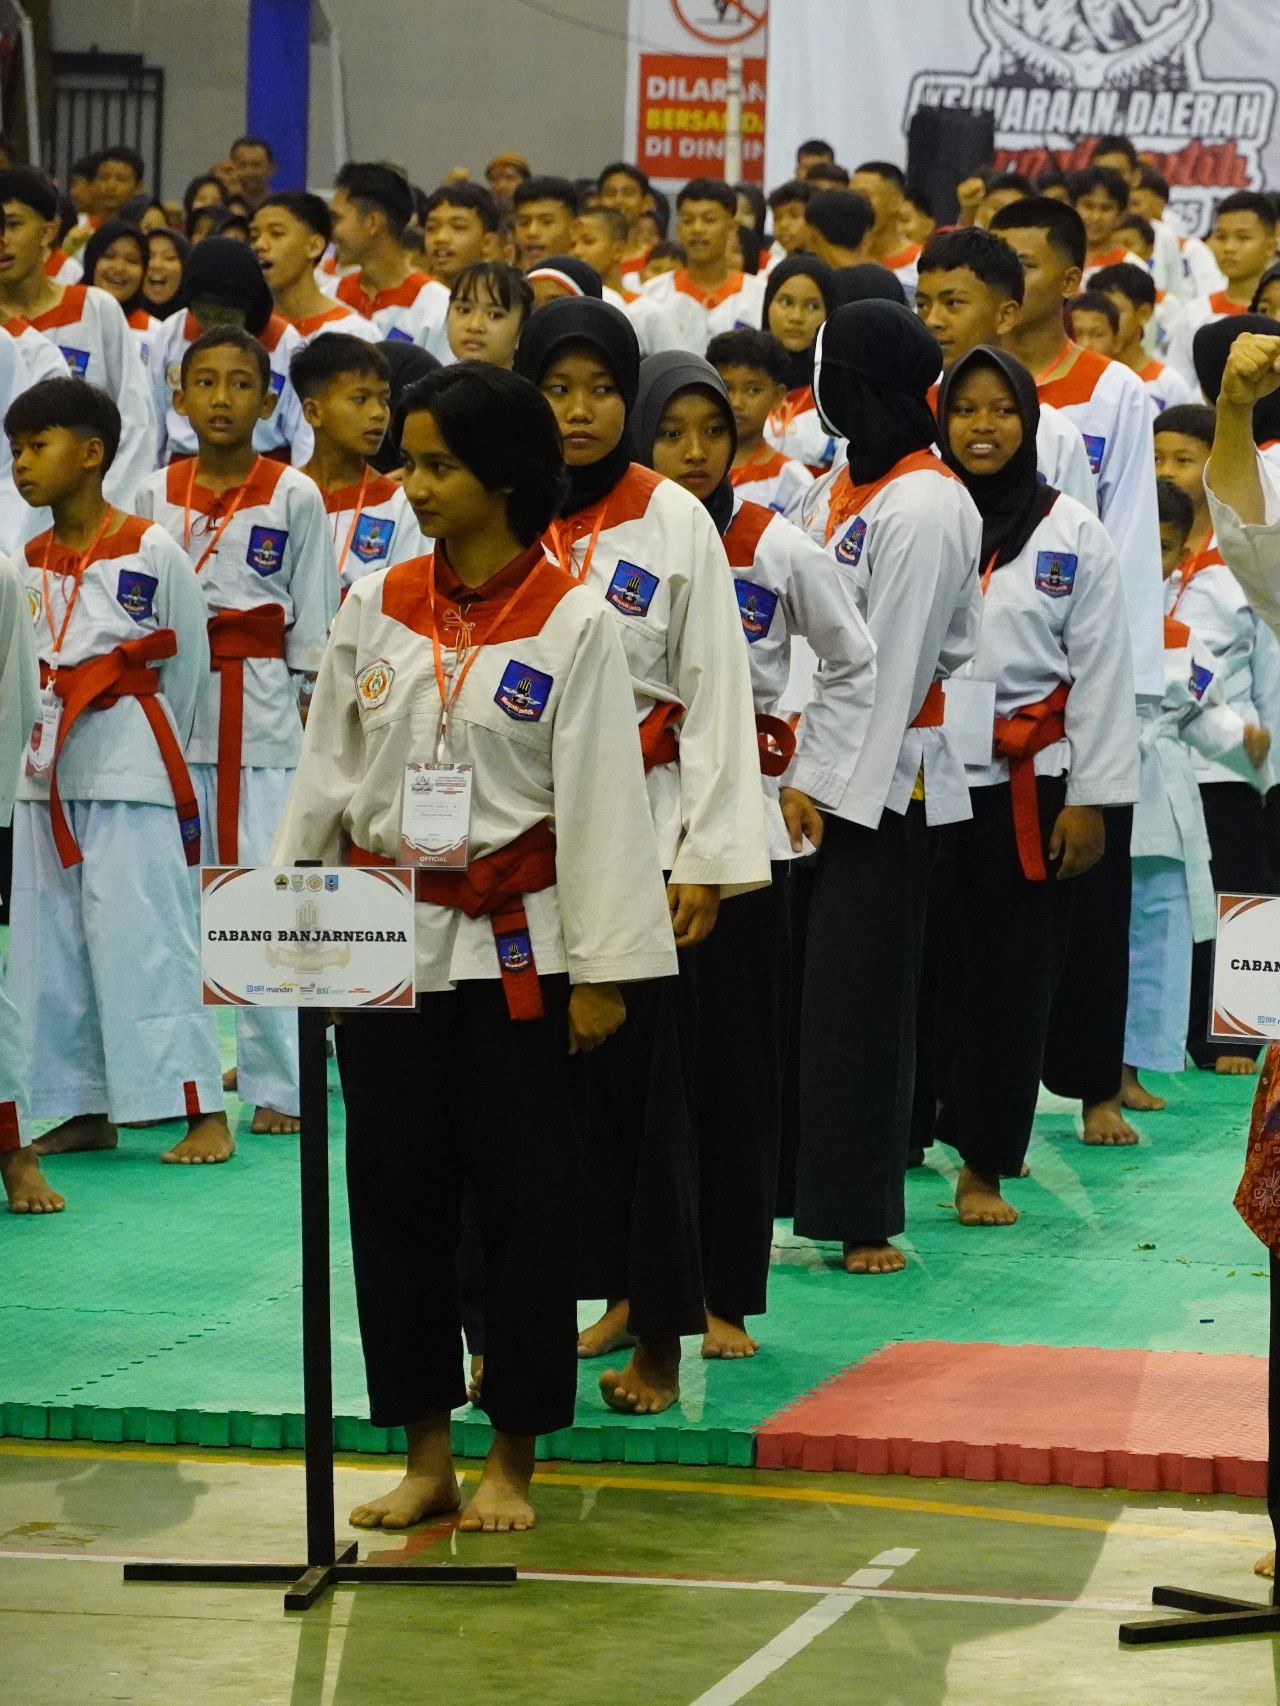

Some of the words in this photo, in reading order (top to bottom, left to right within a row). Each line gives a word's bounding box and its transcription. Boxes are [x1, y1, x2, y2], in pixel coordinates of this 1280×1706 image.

[645, 75, 766, 102] DILARN
[1126, 90, 1263, 137] DAERAH
[644, 135, 673, 158] DI
[207, 930, 273, 943] CABANG
[277, 930, 408, 943] BANJARNEGARA
